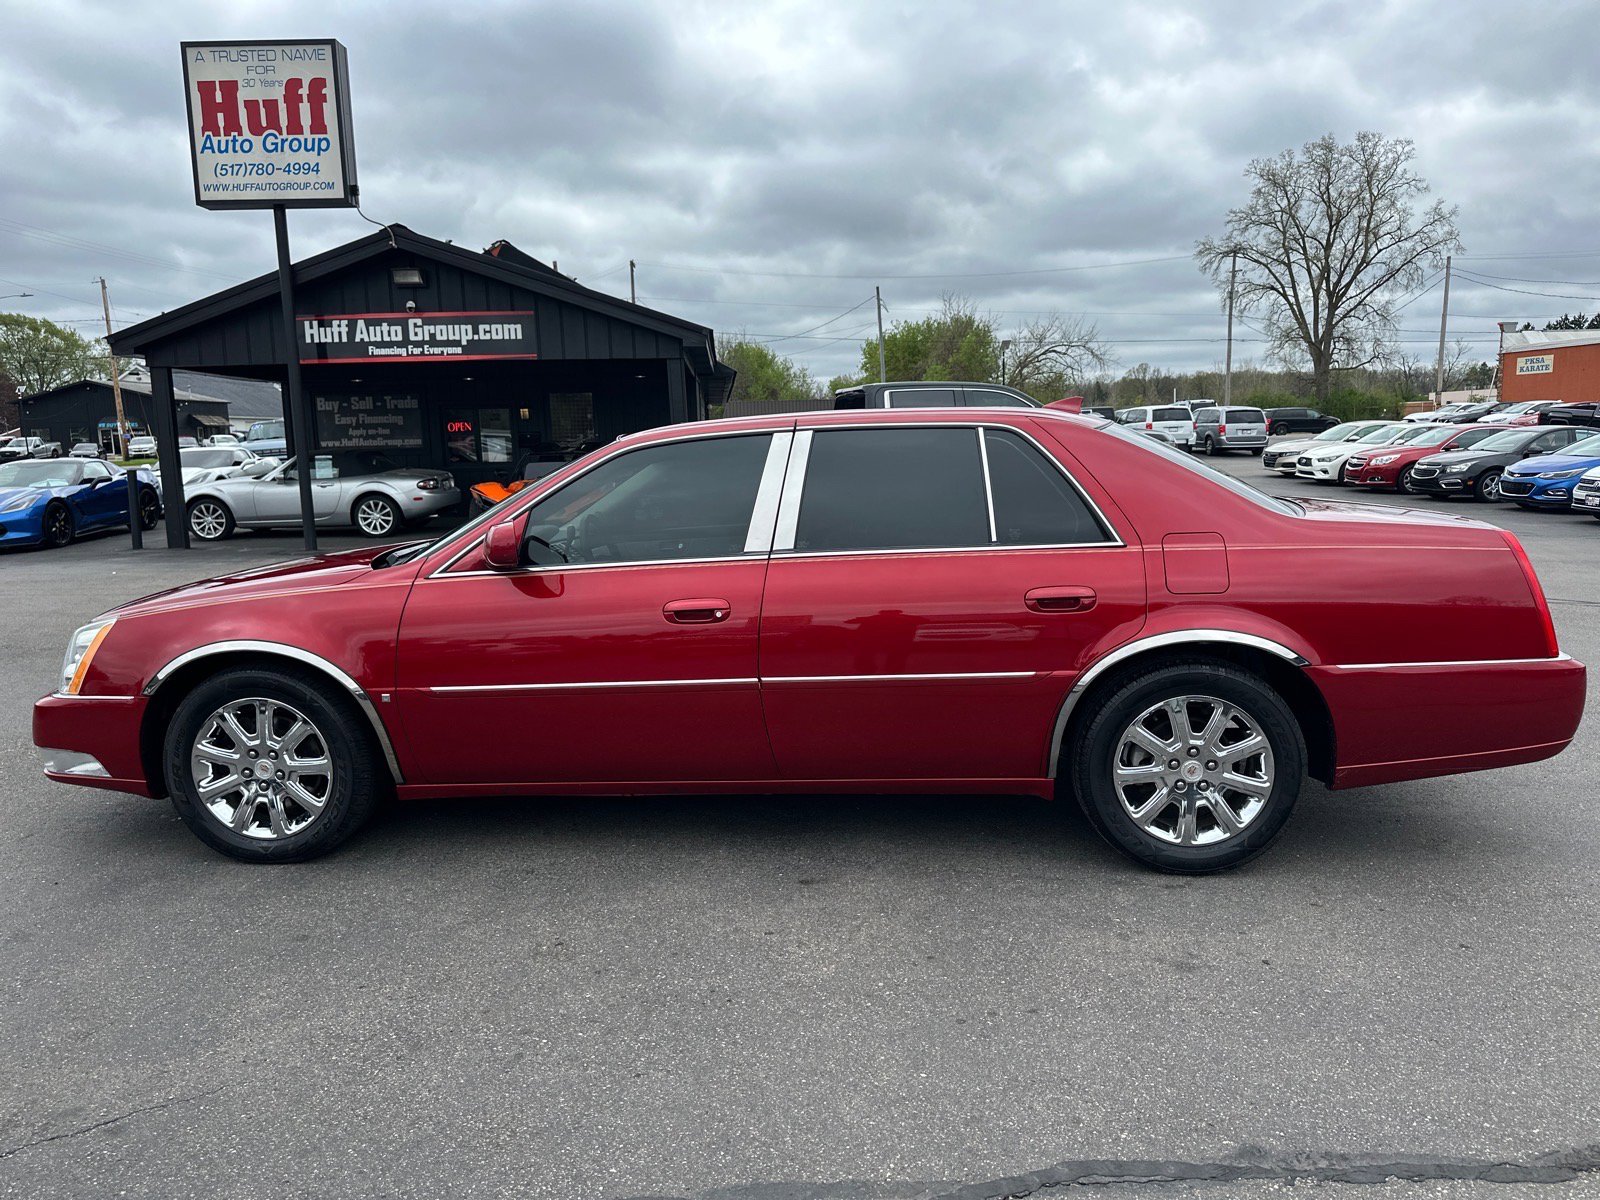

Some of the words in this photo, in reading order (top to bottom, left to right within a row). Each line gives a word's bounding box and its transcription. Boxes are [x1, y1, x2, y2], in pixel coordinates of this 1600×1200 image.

[195, 51, 205, 63] A
[209, 50, 277, 63] TRUSTED
[282, 49, 326, 61] NAME
[246, 65, 275, 75] FOR
[242, 78, 255, 88] 30
[259, 79, 283, 88] Years
[197, 77, 328, 137] Huff
[200, 134, 253, 154] Auto
[262, 132, 331, 156] Group
[214, 162, 320, 178] (517)780-4994
[203, 181, 335, 192] WWW.HUFFAUTOGROUP.COM
[303, 319, 349, 343] Huff
[354, 319, 402, 343] Auto
[408, 318, 523, 345] Group.com
[368, 345, 407, 356] Financing
[408, 345, 422, 355] For
[424, 344, 462, 356] Everyone
[1524, 357, 1545, 365] PKSA
[1519, 364, 1550, 373] KARATE
[316, 397, 340, 412] Buy
[350, 396, 373, 410] Sell
[384, 395, 419, 409] Trade
[335, 414, 357, 426] Easy
[359, 413, 403, 425] Financing
[447, 421, 472, 432] OPEN
